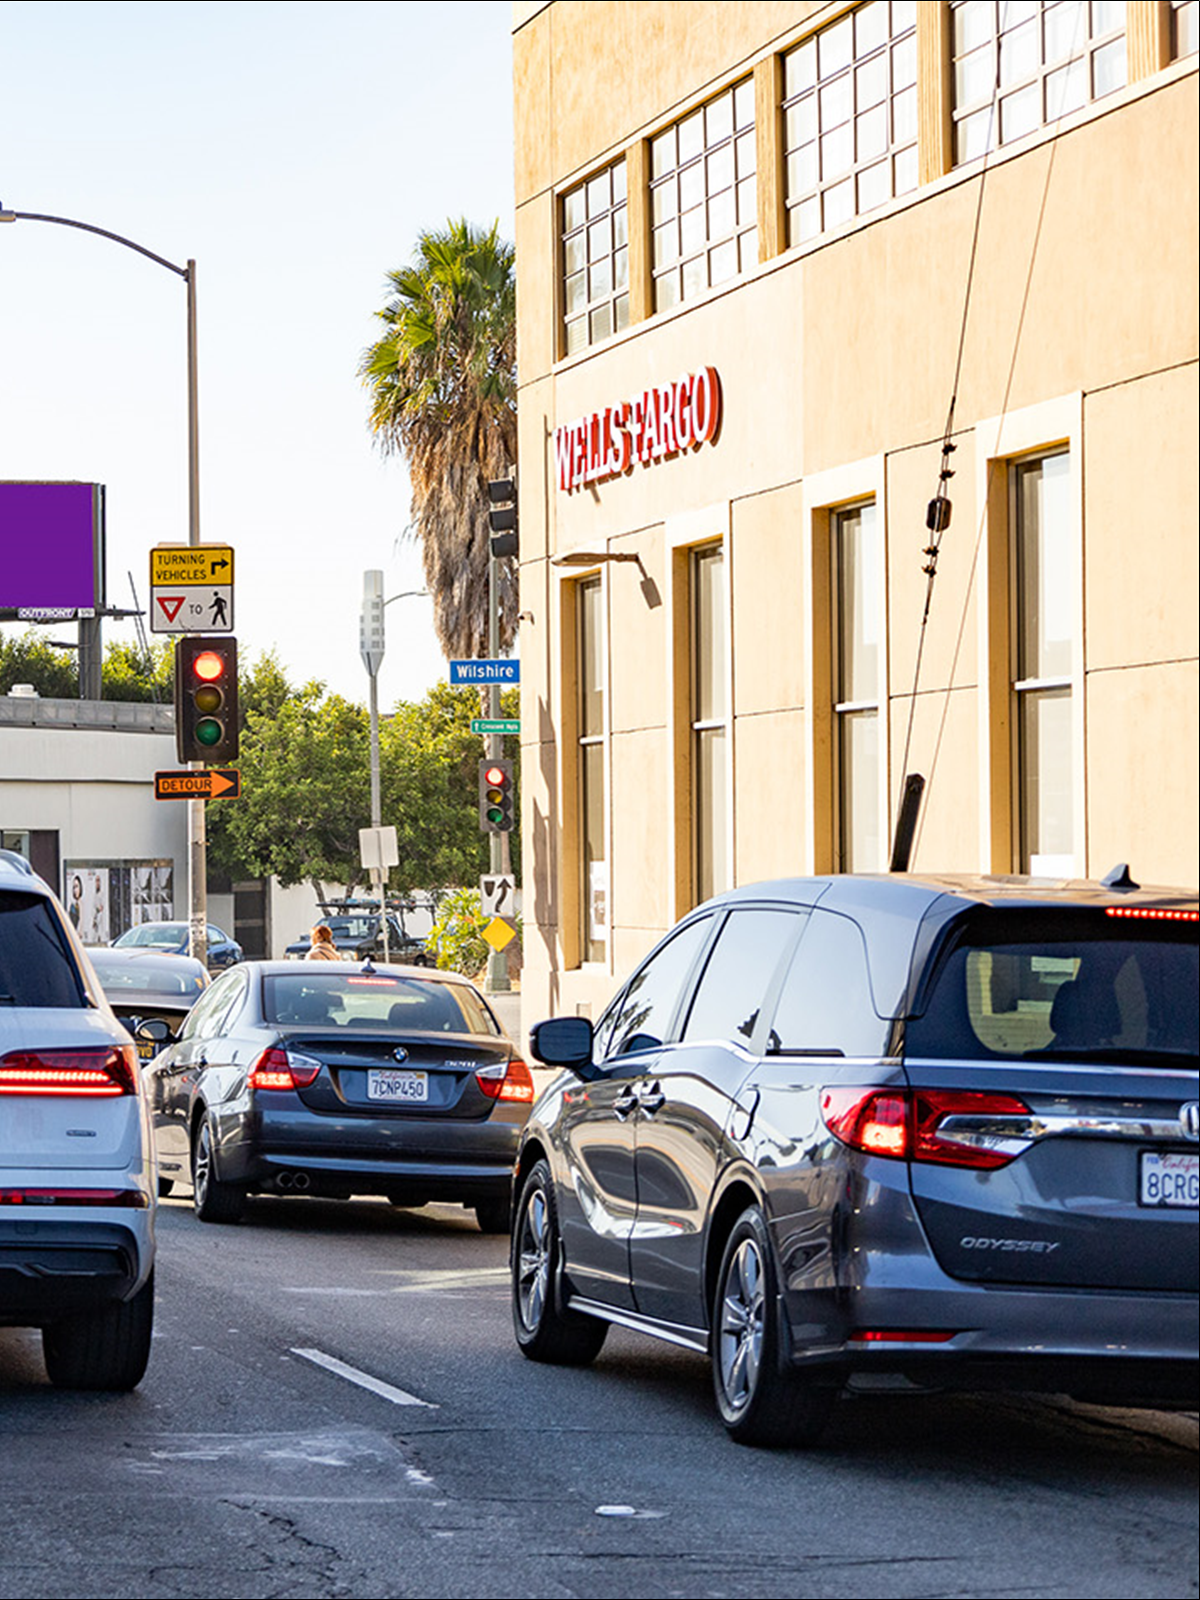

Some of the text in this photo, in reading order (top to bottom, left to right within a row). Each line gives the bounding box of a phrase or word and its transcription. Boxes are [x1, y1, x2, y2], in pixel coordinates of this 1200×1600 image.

[553, 366, 722, 491] WELLS FARGO
[157, 554, 206, 566] TURNING
[156, 569, 207, 581] VEHICLES
[189, 603, 203, 615] TO
[455, 664, 515, 679] Wilshire
[161, 779, 213, 792] DETOUR
[372, 1080, 425, 1097] 7CNP450
[1147, 1172, 1199, 1200] 8CRG
[960, 1236, 1060, 1253] ODYSSEY
